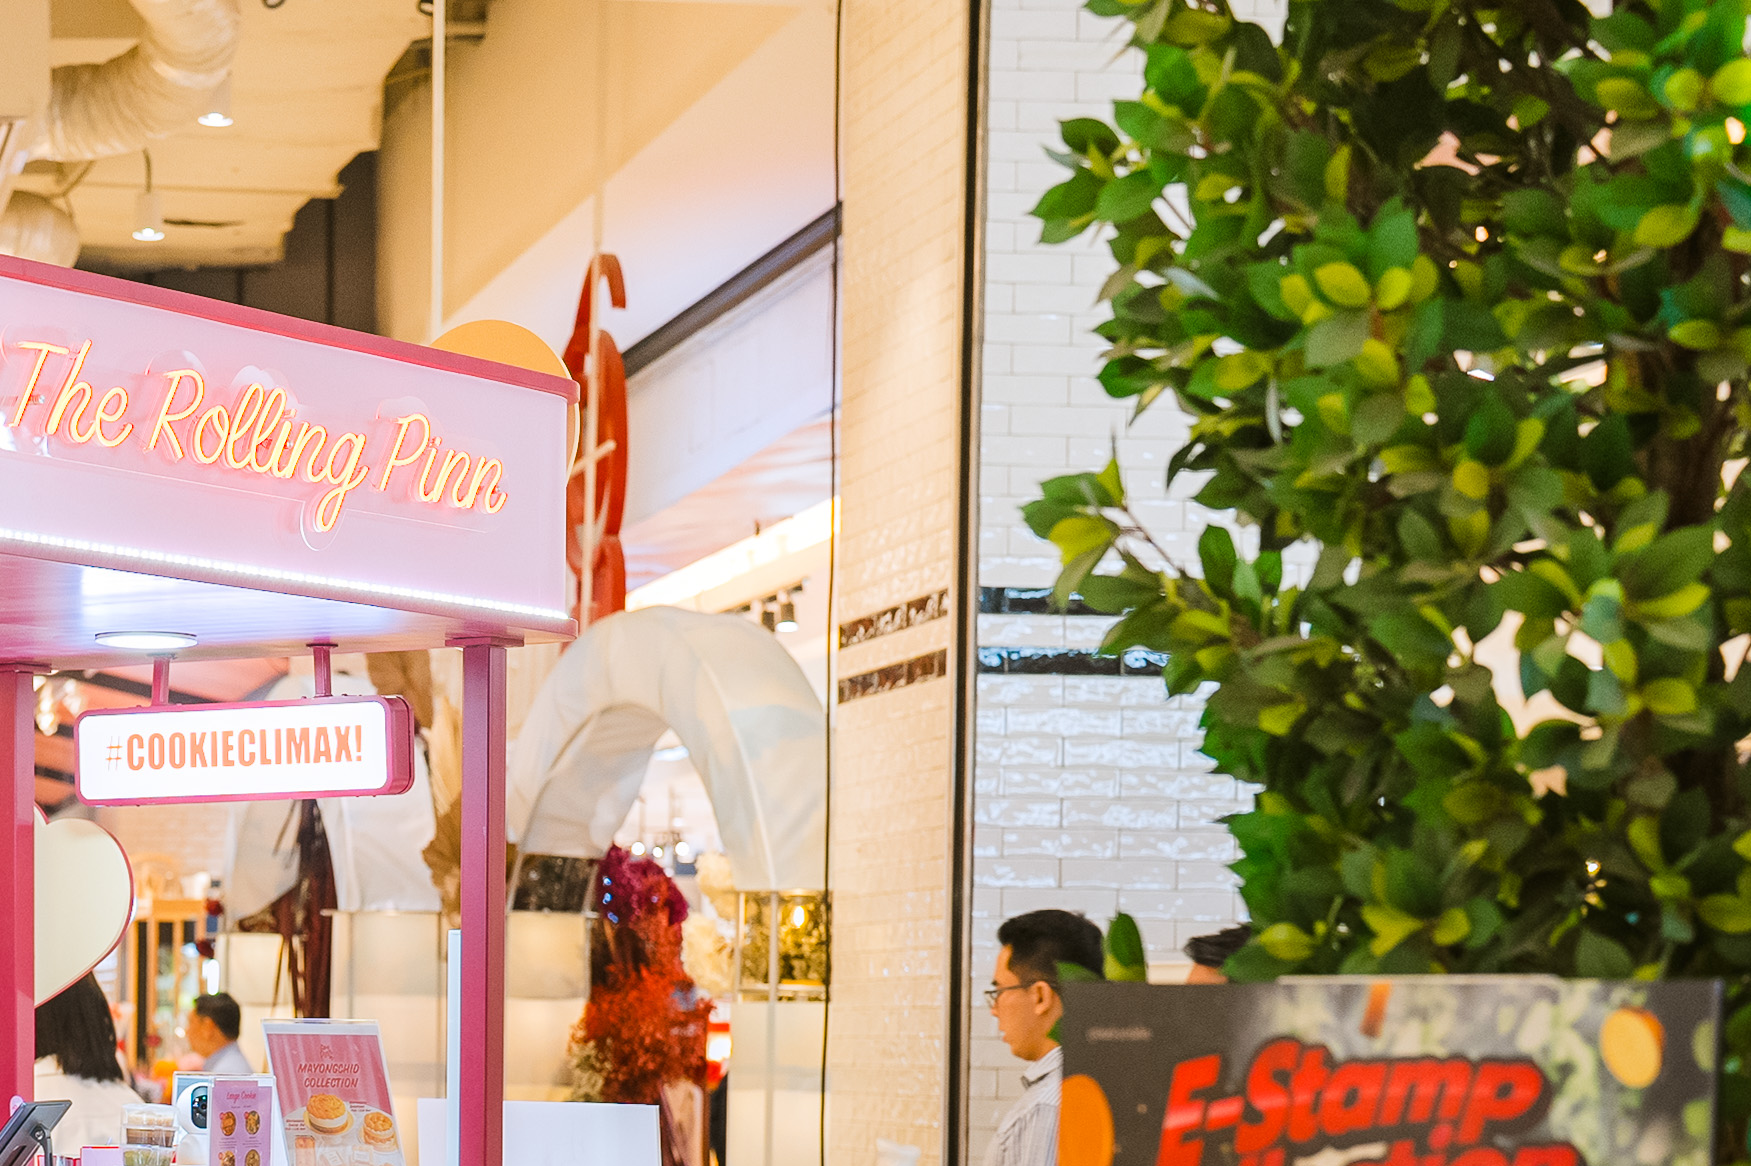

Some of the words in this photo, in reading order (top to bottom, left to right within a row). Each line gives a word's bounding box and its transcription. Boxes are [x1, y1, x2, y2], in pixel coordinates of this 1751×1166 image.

[8, 339, 134, 447] The
[145, 368, 369, 533] Rolling
[377, 412, 508, 515] Pinn
[106, 724, 363, 772] #COOKIECLIMAX!
[304, 1077, 359, 1088] COLLECTION
